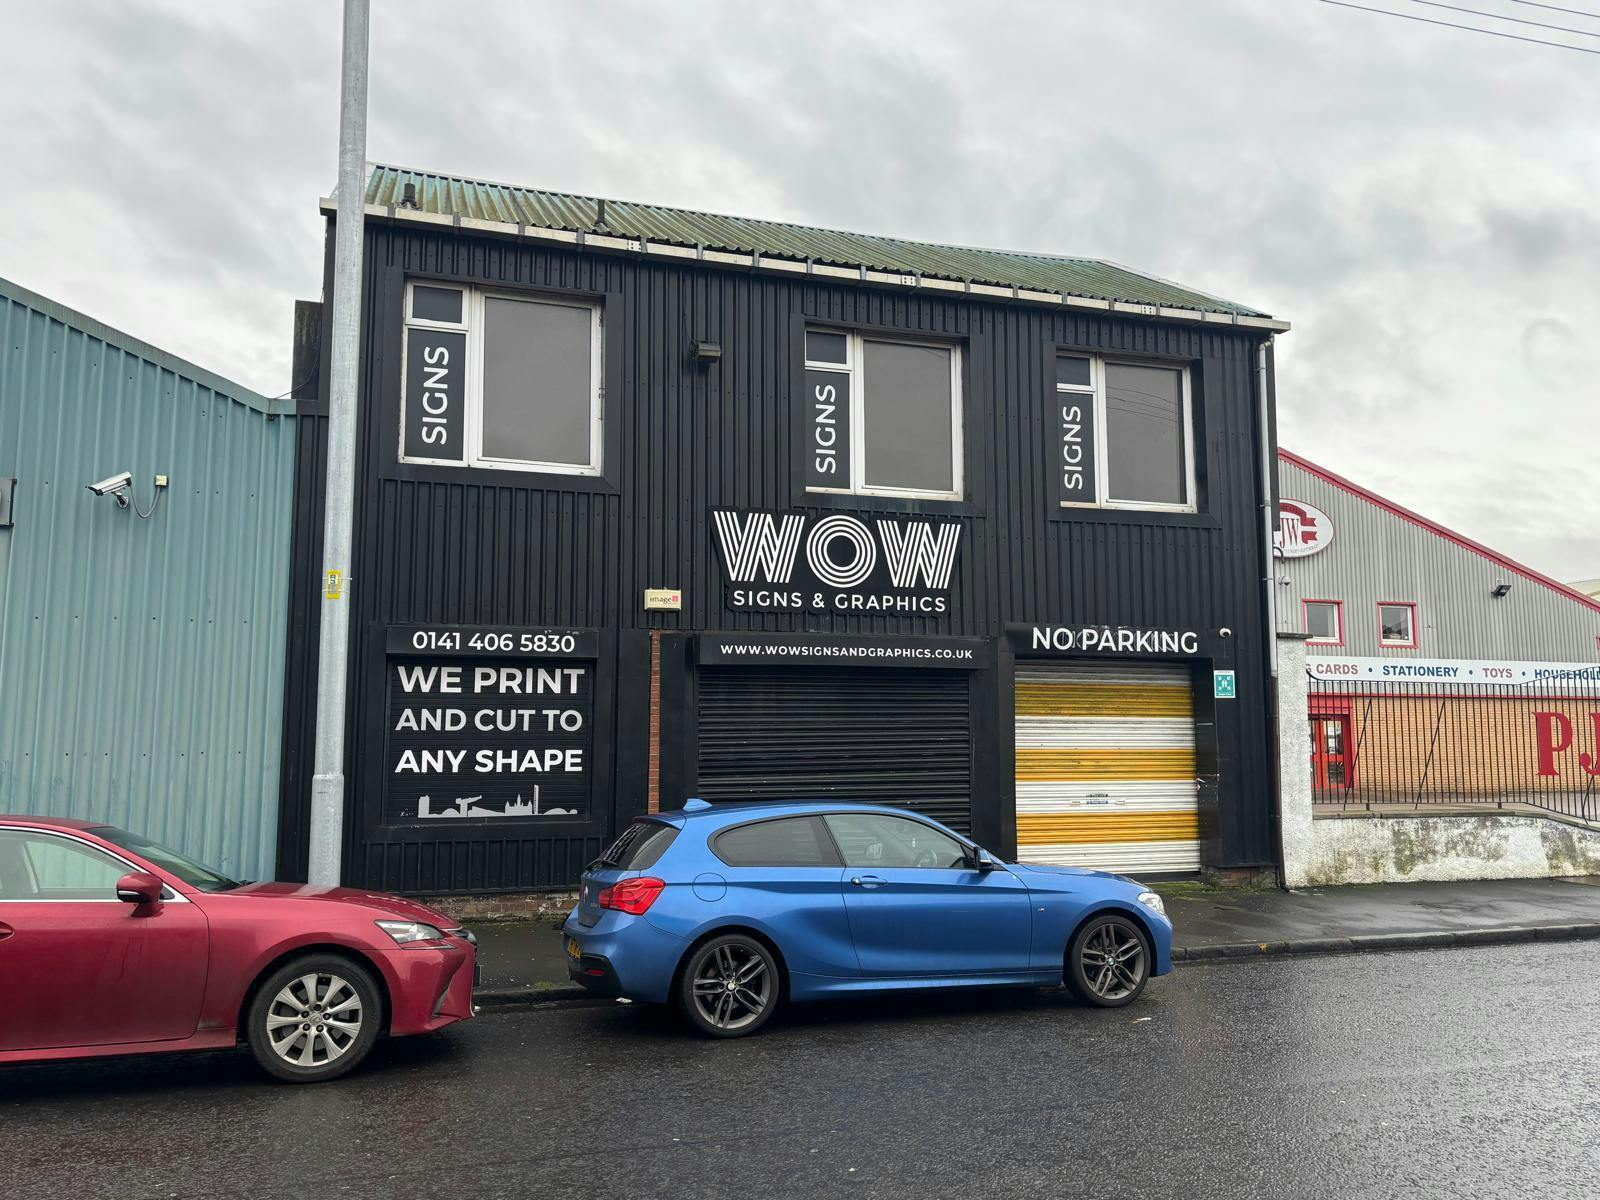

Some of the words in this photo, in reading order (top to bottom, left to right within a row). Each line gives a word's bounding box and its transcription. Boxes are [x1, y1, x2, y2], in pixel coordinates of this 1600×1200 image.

[421, 346, 450, 445] SIGNS
[814, 384, 837, 474] SIGNS
[1062, 406, 1083, 490] SIGNS
[713, 510, 962, 589] WOW
[733, 590, 802, 608] SIGNS
[812, 592, 825, 608] &
[834, 593, 946, 612] GRAPHICS
[412, 631, 461, 650] 0141
[467, 633, 514, 651] 406
[519, 634, 576, 653] 5830
[720, 644, 973, 660] WWW.WOWSIGNSANDGRAPHICS.CO.UK
[1032, 627, 1074, 651] NO
[1081, 628, 1198, 654] PARKING
[397, 665, 462, 694] WE
[473, 667, 585, 694] PRINT
[1316, 663, 1359, 675] CARDS
[1382, 665, 1459, 678] STATIONERY
[1482, 667, 1513, 679] TOYS
[395, 708, 467, 731] AND
[474, 709, 535, 731] CUT
[542, 709, 583, 732] TO
[394, 749, 467, 773] ANY
[474, 749, 583, 773] SHAPE
